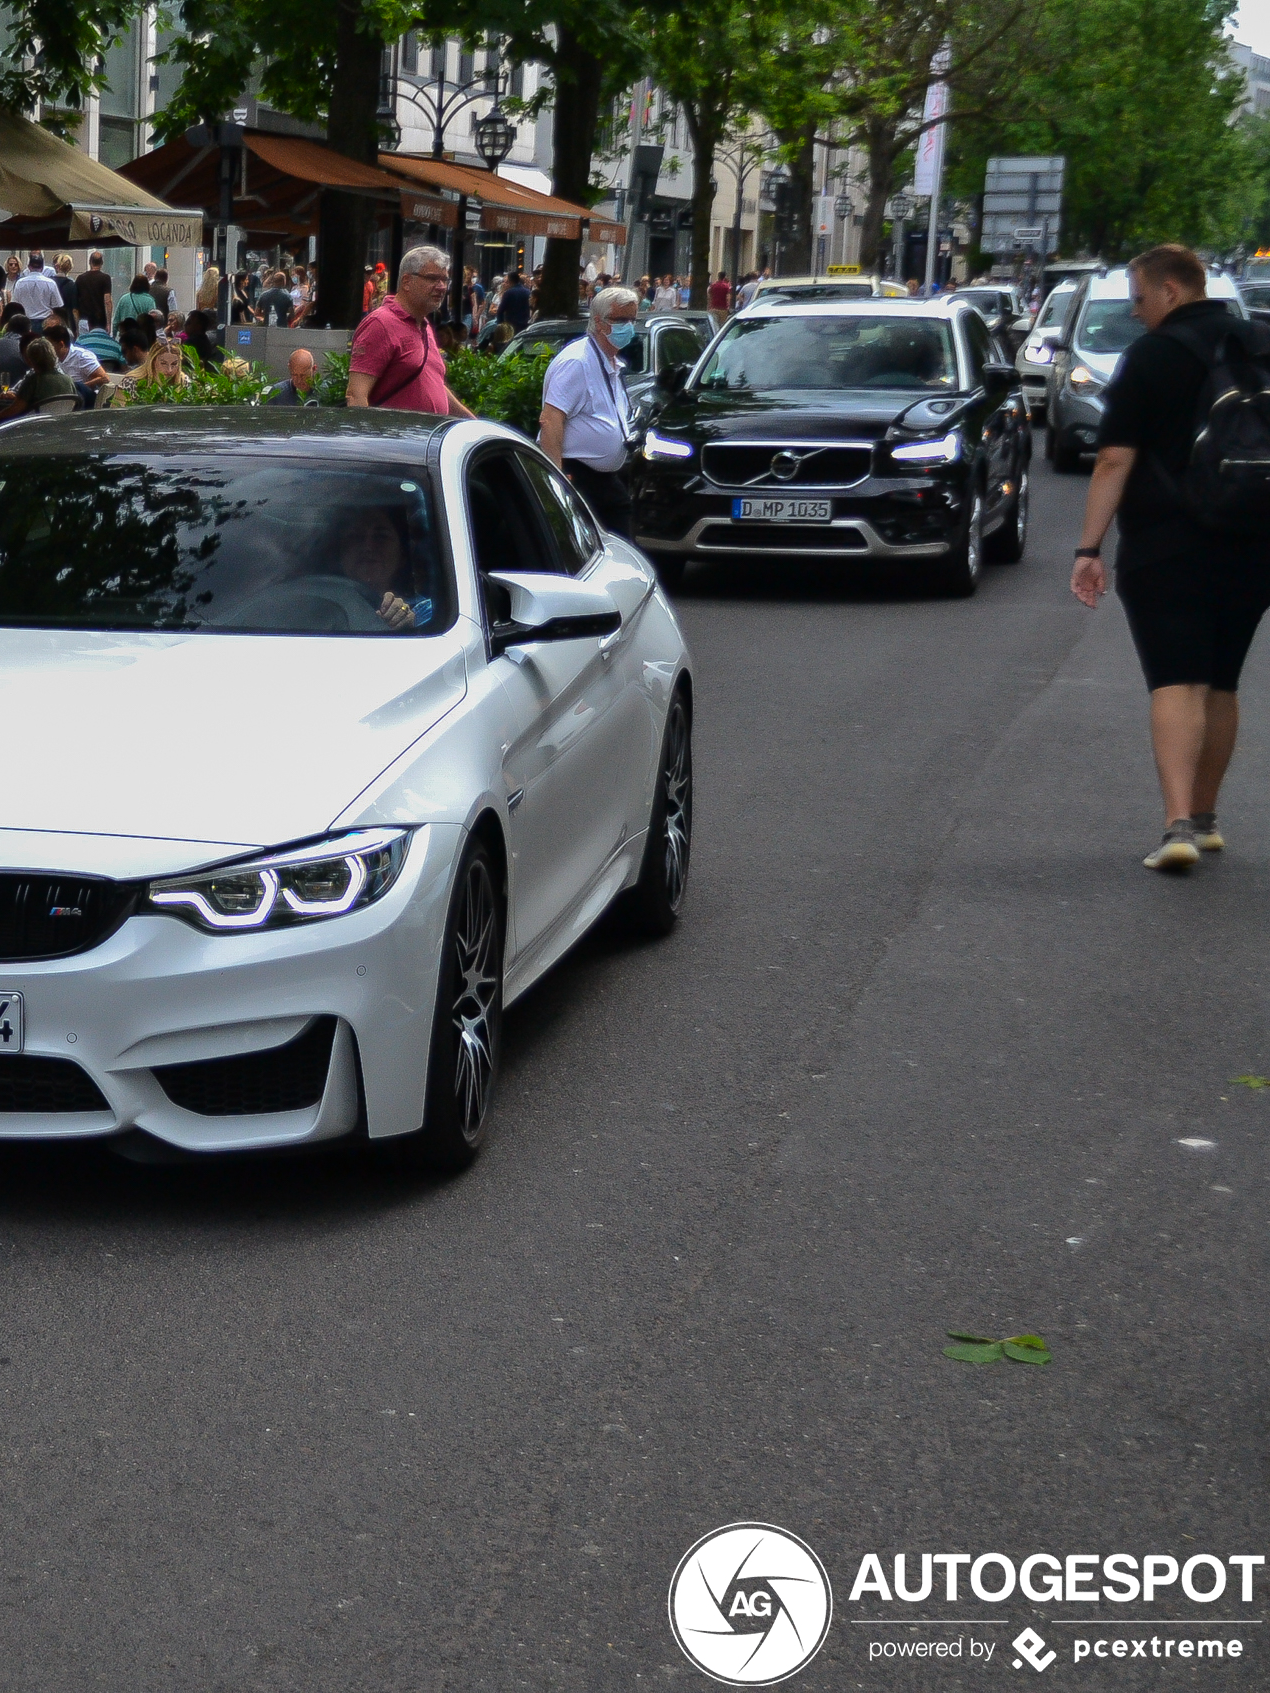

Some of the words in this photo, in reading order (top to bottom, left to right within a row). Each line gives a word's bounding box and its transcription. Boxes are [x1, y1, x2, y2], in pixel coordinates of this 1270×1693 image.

[146, 221, 192, 243] LOCANDA
[741, 501, 752, 516] D
[762, 501, 784, 517] MP
[787, 502, 829, 518] 1035
